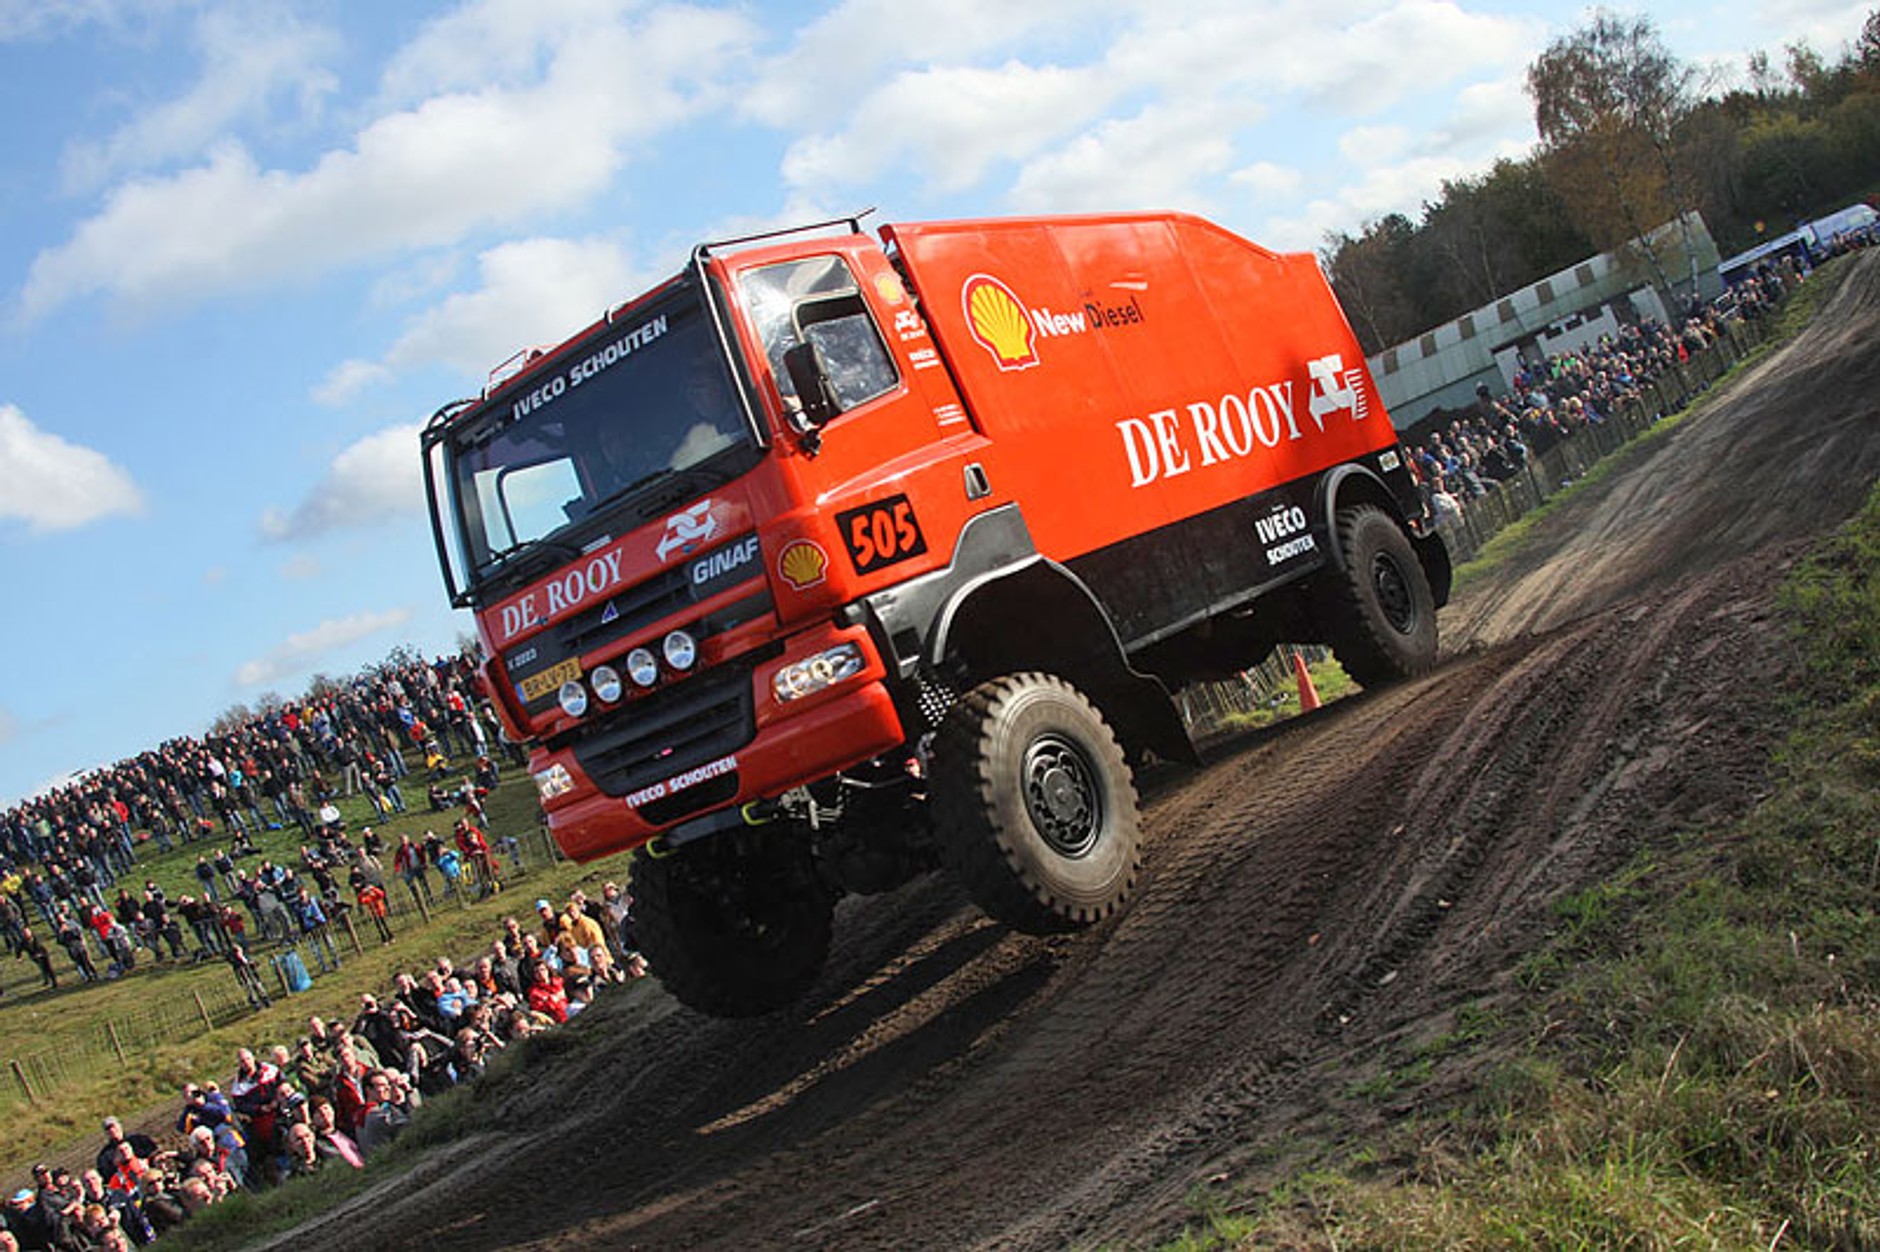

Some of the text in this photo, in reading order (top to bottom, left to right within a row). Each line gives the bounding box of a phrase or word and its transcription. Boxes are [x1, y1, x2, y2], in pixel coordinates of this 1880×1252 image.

[1031, 295, 1144, 337] New Diesel
[512, 314, 668, 420] IVECO SCHOUTEN
[1115, 381, 1302, 488] DE ROOY
[851, 501, 917, 567] 505
[1255, 506, 1306, 544] IVECO
[693, 536, 759, 584] GINAF
[502, 547, 622, 639] DE ROOY
[626, 755, 737, 809] IVECO SCHOUTEN
